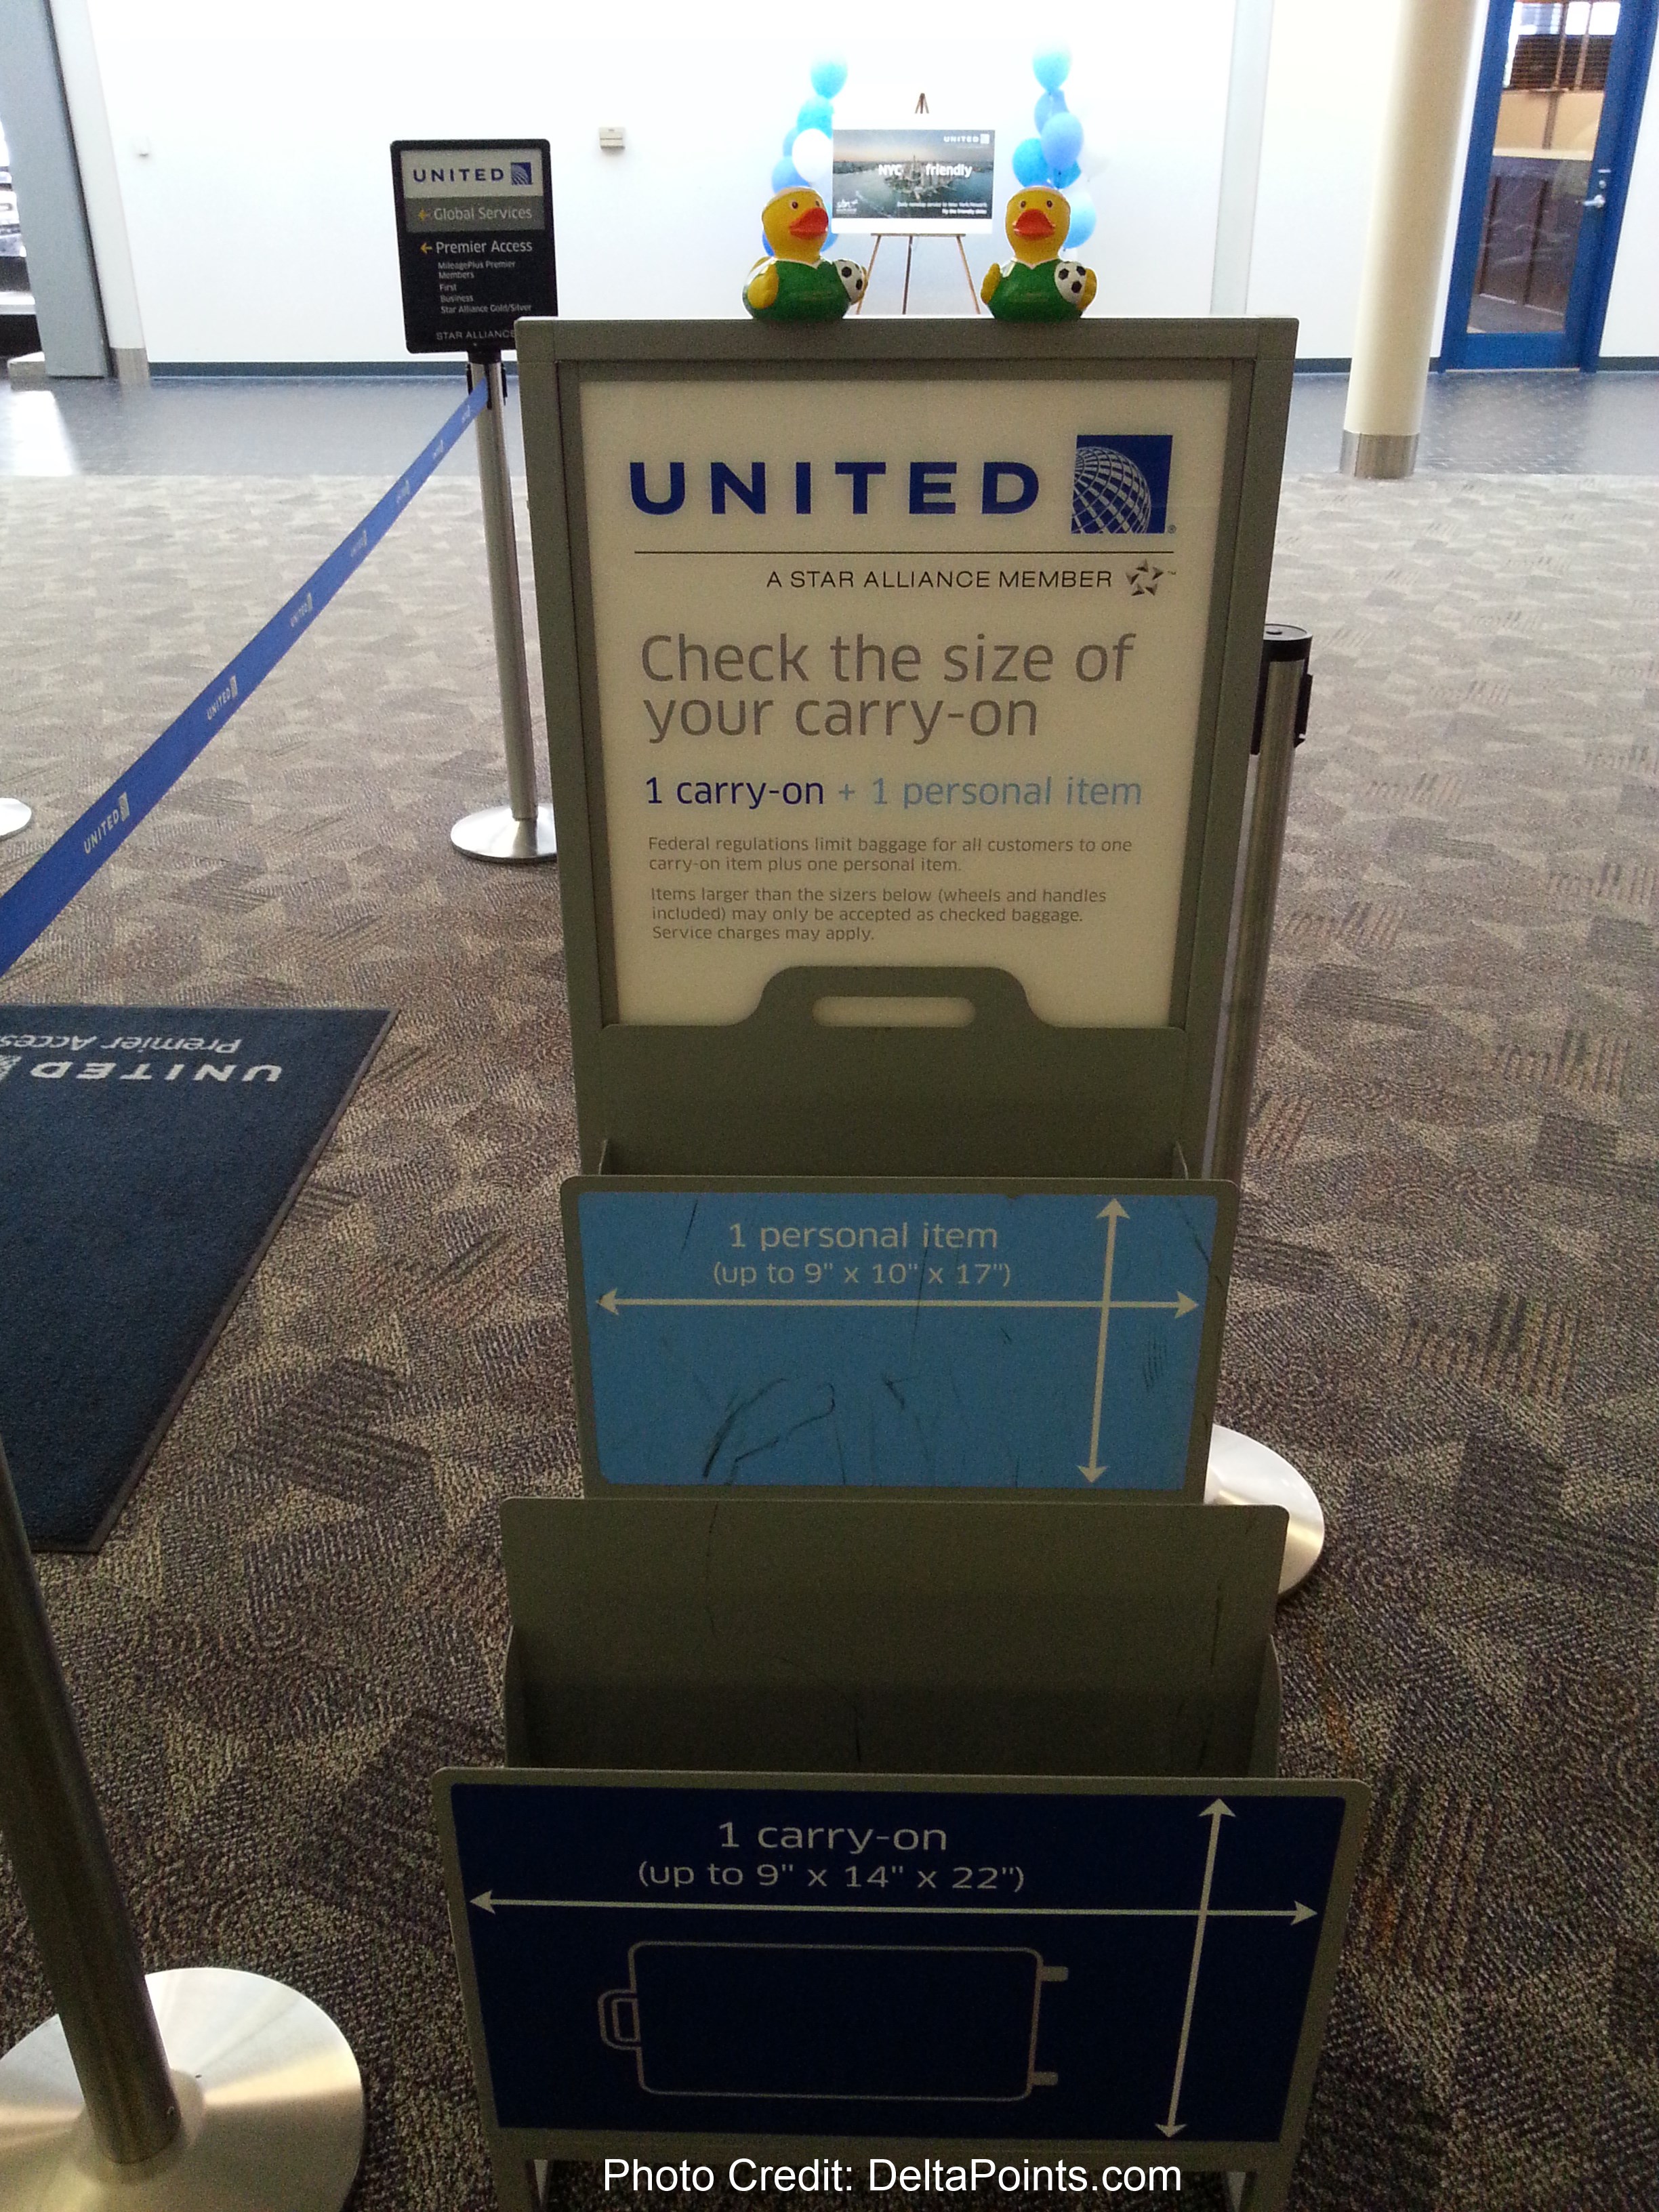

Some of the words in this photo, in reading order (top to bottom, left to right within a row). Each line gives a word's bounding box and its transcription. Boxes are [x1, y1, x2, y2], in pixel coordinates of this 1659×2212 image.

[413, 169, 504, 182] UNITED
[878, 164, 903, 176] NYC
[925, 163, 972, 178] friendly
[434, 207, 474, 220] Global
[478, 207, 533, 219] Services
[436, 241, 487, 253] Premier
[491, 240, 533, 253] Access
[485, 260, 516, 268] Premier
[440, 283, 457, 291] First
[441, 295, 474, 303] Business
[441, 306, 456, 314] Star
[436, 331, 463, 340] STAR
[630, 462, 1040, 515] UNITED
[766, 571, 782, 588] A
[790, 571, 855, 588] STAR
[863, 571, 990, 588] ALLIANCE
[998, 571, 1112, 588] MEMBER
[641, 634, 809, 682] Check
[830, 634, 922, 682] the
[943, 635, 1054, 682] size
[1075, 634, 1136, 682] of
[207, 688, 231, 721] UNITED
[643, 698, 774, 744] your
[795, 699, 1038, 745] carry-on
[646, 777, 662, 804] 1
[676, 778, 824, 809] carry-on
[839, 785, 855, 802] +
[872, 778, 888, 805] 1
[904, 777, 1051, 809] personal
[1067, 777, 1142, 805] item
[84, 809, 119, 854] UNITED
[649, 837, 710, 851] Federal
[716, 837, 808, 853] regulations
[815, 838, 852, 851] limit
[858, 838, 927, 853] baggage
[933, 838, 956, 851] for
[962, 838, 981, 851] all
[987, 840, 1073, 852] customers
[1079, 840, 1095, 852] to
[1101, 842, 1132, 852] one
[649, 859, 720, 872] carry-on
[726, 858, 762, 870] item
[769, 858, 802, 872] plus
[808, 861, 837, 871] one
[844, 858, 915, 872] personal
[921, 858, 962, 872] item.
[651, 888, 696, 901] Items
[702, 888, 749, 903] larger
[755, 888, 792, 901] than
[798, 888, 824, 901] the
[830, 888, 877, 901] sizers
[882, 888, 932, 901] below
[939, 888, 1001, 903] (wheels
[1006, 889, 1036, 902] and
[1042, 889, 1106, 902] handles
[653, 907, 726, 922] included)
[733, 910, 767, 922] may
[773, 907, 808, 922] only
[815, 907, 834, 920] be
[839, 908, 911, 922] accepted
[917, 912, 933, 921] as
[939, 908, 1006, 921] checked
[1012, 909, 1083, 924] baggage.
[653, 926, 712, 939] Service
[718, 926, 779, 941] charges
[785, 929, 820, 941] may
[825, 926, 874, 942] apply.
[0, 1034, 97, 1050] Acces
[101, 1036, 242, 1054] Premier
[30, 1061, 282, 1082] UNITED
[729, 1223, 746, 1248] 1
[760, 1222, 908, 1252] personal
[923, 1223, 999, 1248] item
[713, 1261, 757, 1286] (up
[766, 1263, 795, 1284] to
[804, 1263, 834, 1284] 9"
[844, 1267, 859, 1284] x
[872, 1263, 918, 1284] 10"
[928, 1267, 944, 1284] x
[956, 1263, 1011, 1288] 17")
[719, 1821, 739, 1848] 1
[757, 1826, 947, 1855] carry-on
[638, 1861, 695, 1888] (up
[707, 1863, 744, 1885] to
[756, 1863, 794, 1887] 9"
[807, 1868, 828, 1887] x
[845, 1866, 904, 1888] 14"
[917, 1870, 937, 1889] x
[952, 1866, 1025, 1893] 22")
